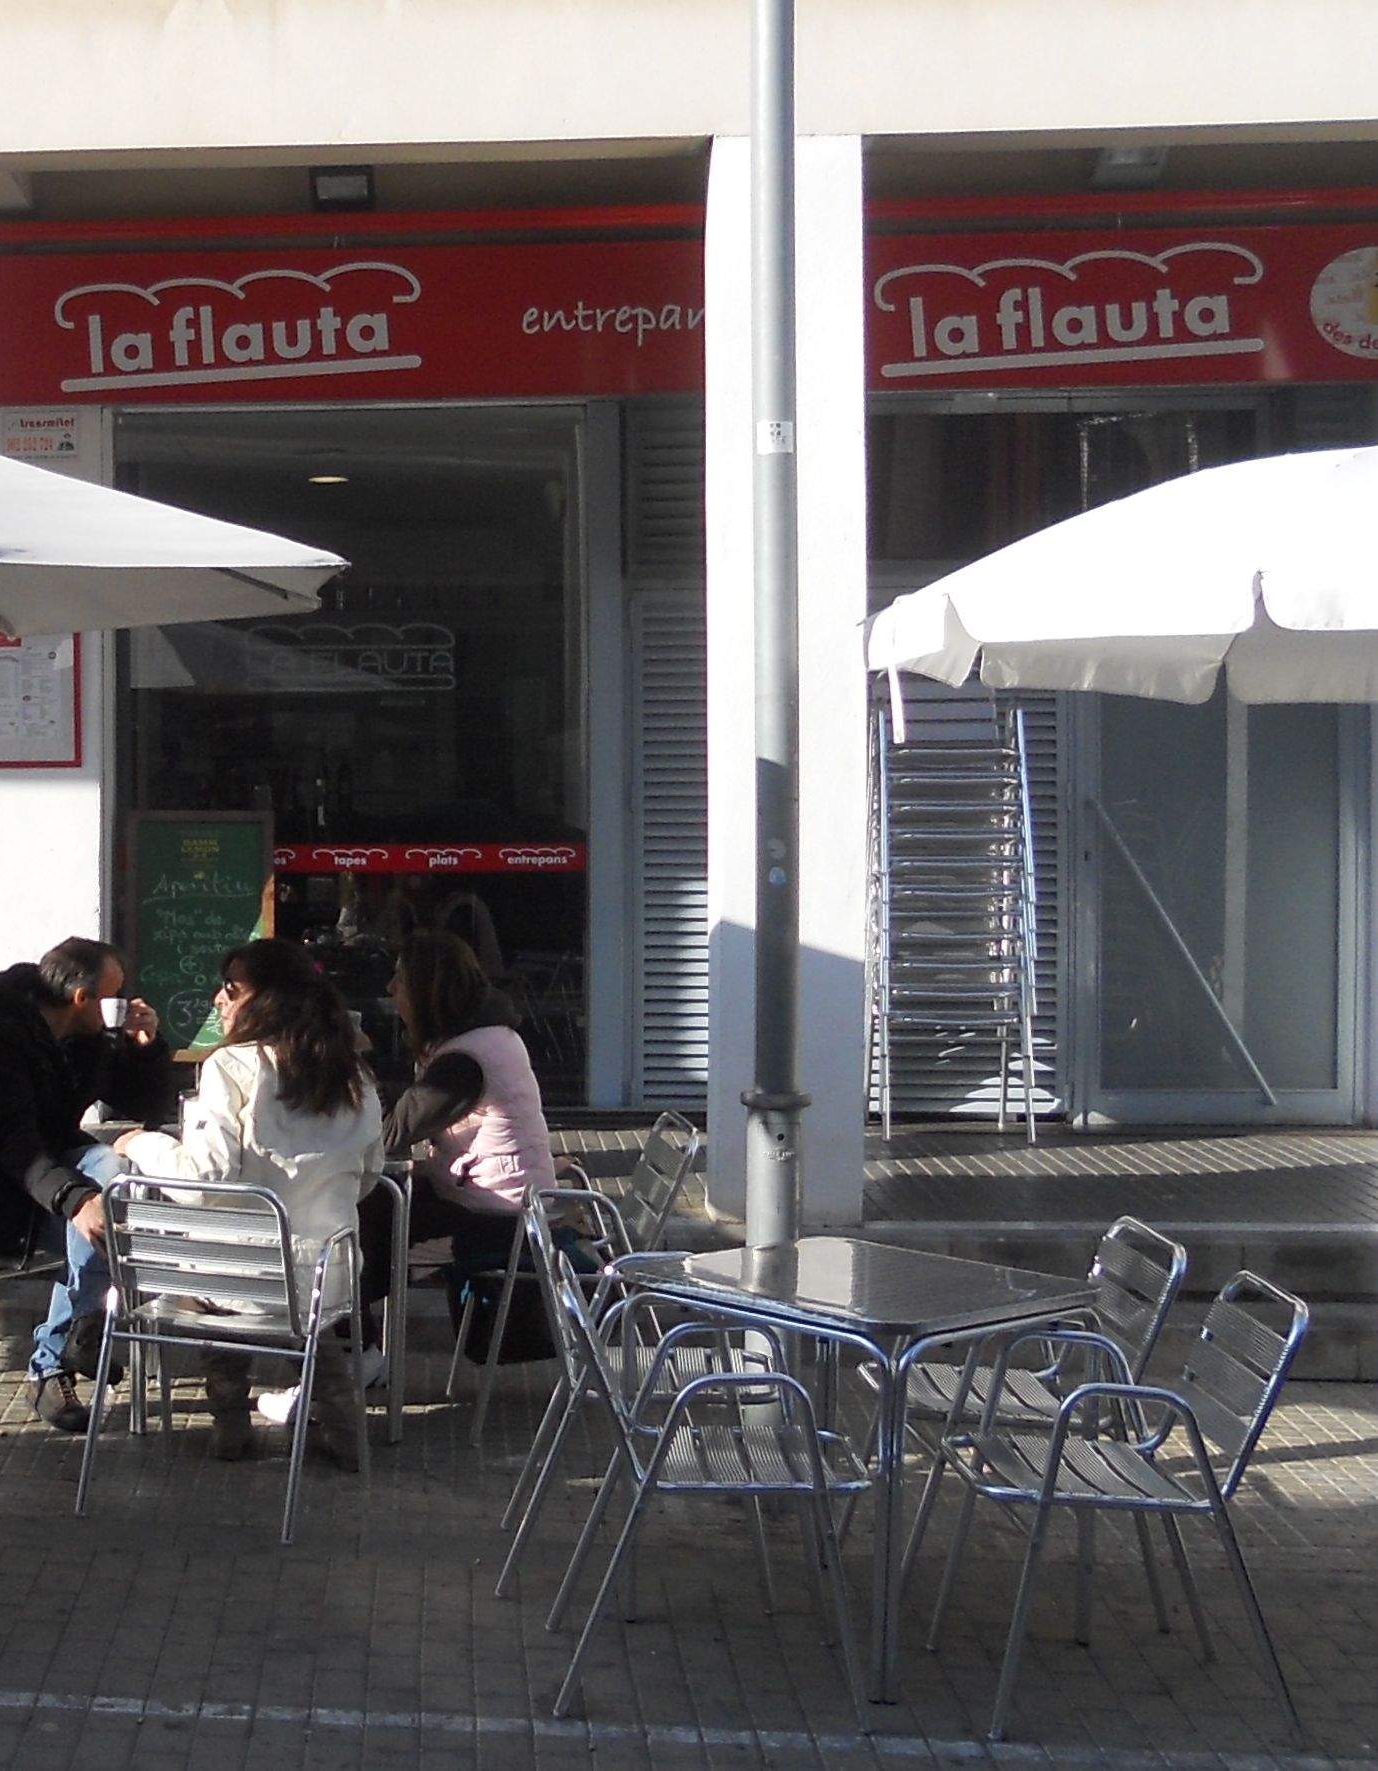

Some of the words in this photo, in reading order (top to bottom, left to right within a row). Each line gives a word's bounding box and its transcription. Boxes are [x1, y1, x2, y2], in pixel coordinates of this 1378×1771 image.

[910, 297, 978, 358] la
[996, 286, 1232, 351] flauta
[87, 315, 153, 374] la
[169, 304, 390, 369] flauta
[332, 854, 365, 868] tapes
[428, 853, 459, 868] plats
[507, 853, 567, 868] entrepans
